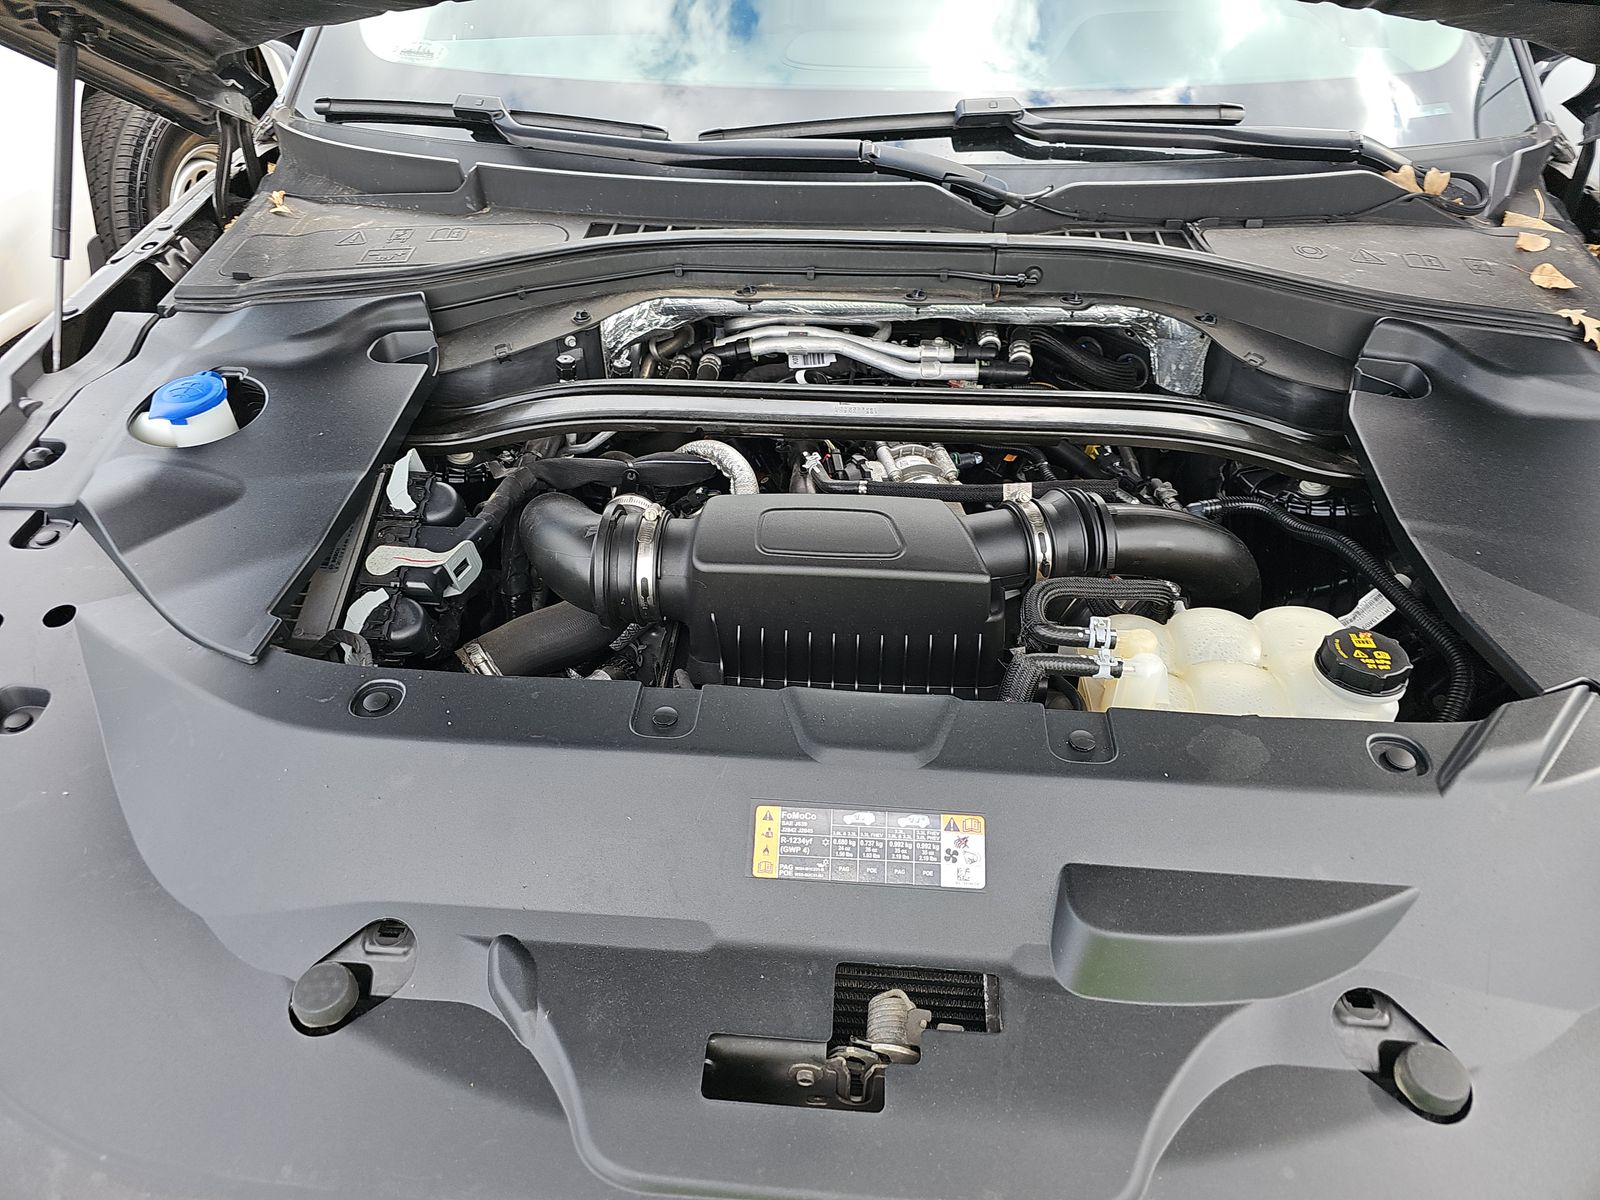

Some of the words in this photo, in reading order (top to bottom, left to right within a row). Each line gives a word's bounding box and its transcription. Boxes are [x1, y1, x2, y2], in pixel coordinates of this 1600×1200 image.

[782, 811, 816, 820] FoMoCo
[780, 836, 813, 846] R-1234yf
[780, 846, 801, 854] (GWP
[802, 847, 810, 855] 4)
